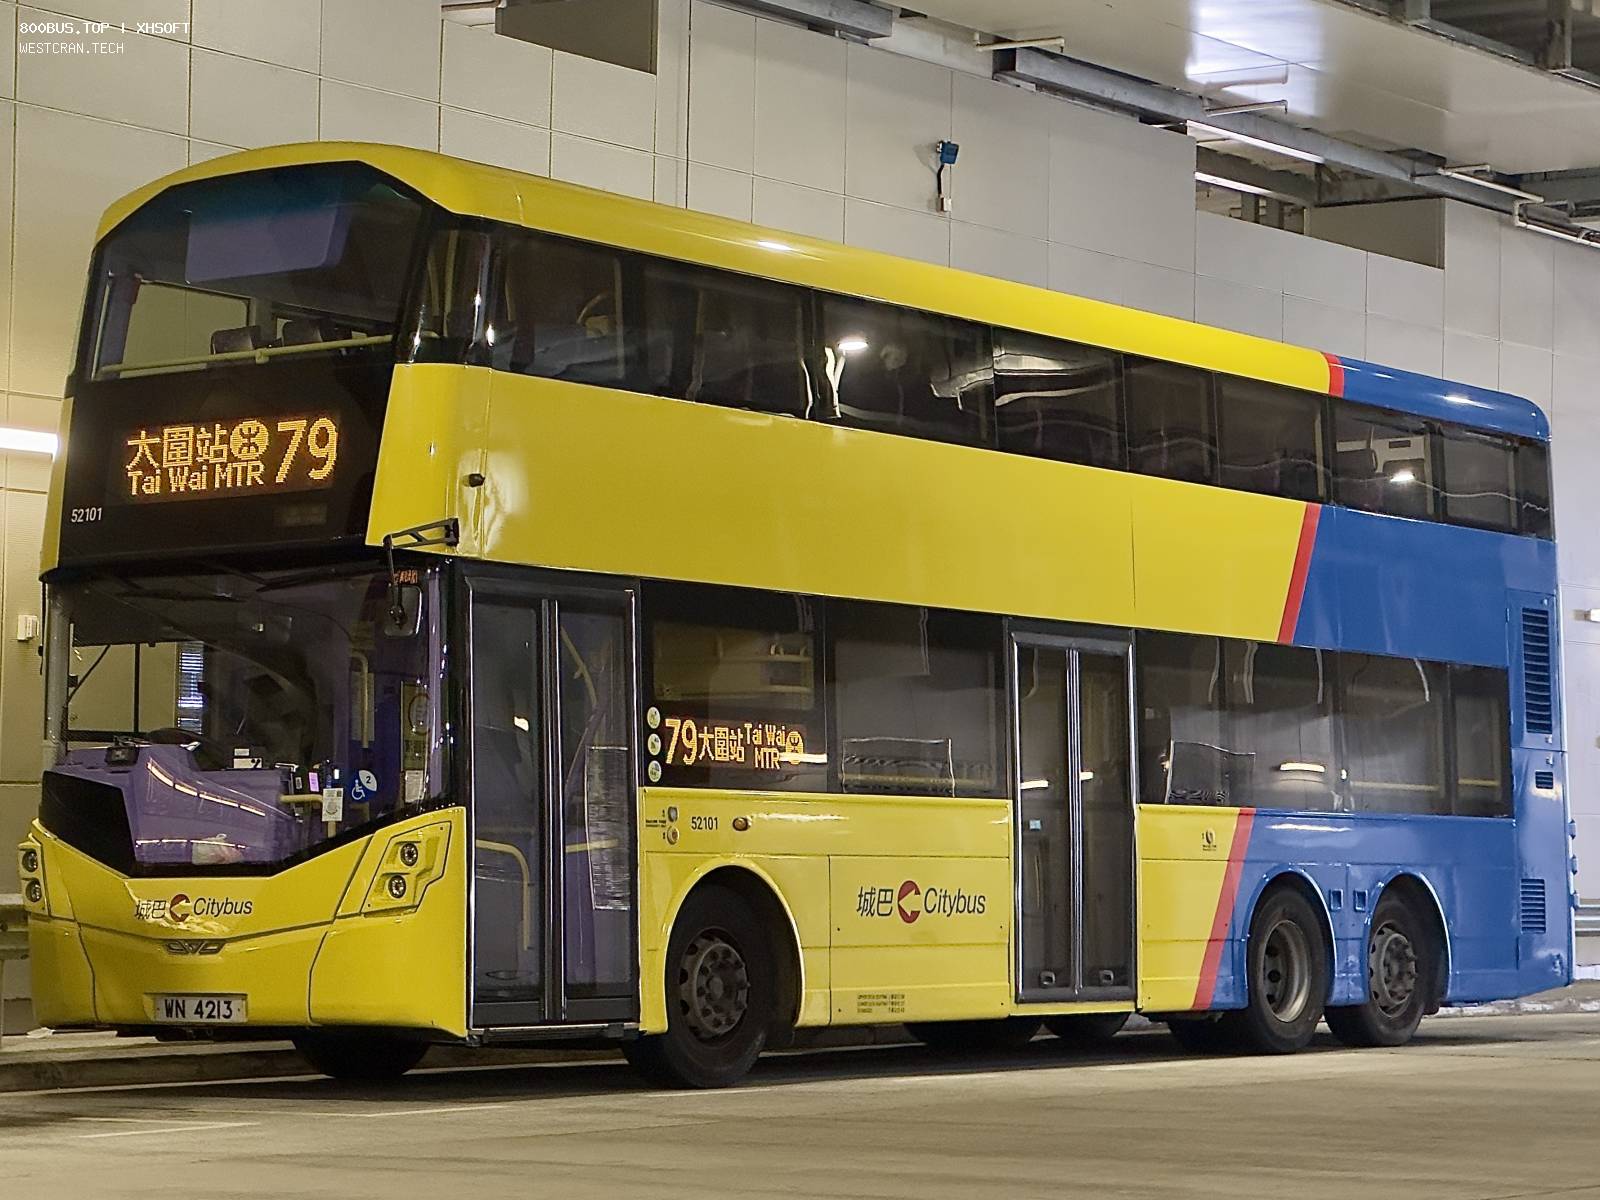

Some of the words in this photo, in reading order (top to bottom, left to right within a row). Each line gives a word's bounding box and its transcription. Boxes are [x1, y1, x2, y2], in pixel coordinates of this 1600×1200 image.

[126, 423, 228, 471] 大圍站
[275, 417, 339, 483] 79
[127, 469, 161, 496] Tai
[169, 464, 208, 493] Wai
[215, 460, 265, 489] MTR
[70, 507, 103, 524] 52101
[665, 718, 698, 766] 79
[698, 726, 745, 763] 大圍站
[744, 723, 763, 745] Tai
[765, 724, 787, 747] Wai
[755, 747, 781, 770] MTR
[365, 775, 372, 784] 2
[691, 816, 719, 830] 52101
[135, 899, 167, 920] 城巴
[193, 897, 253, 918] Citybus
[856, 886, 894, 918] 城巴
[923, 887, 986, 918] Citybus
[164, 999, 186, 1019] WN
[194, 1000, 233, 1020] 4213
